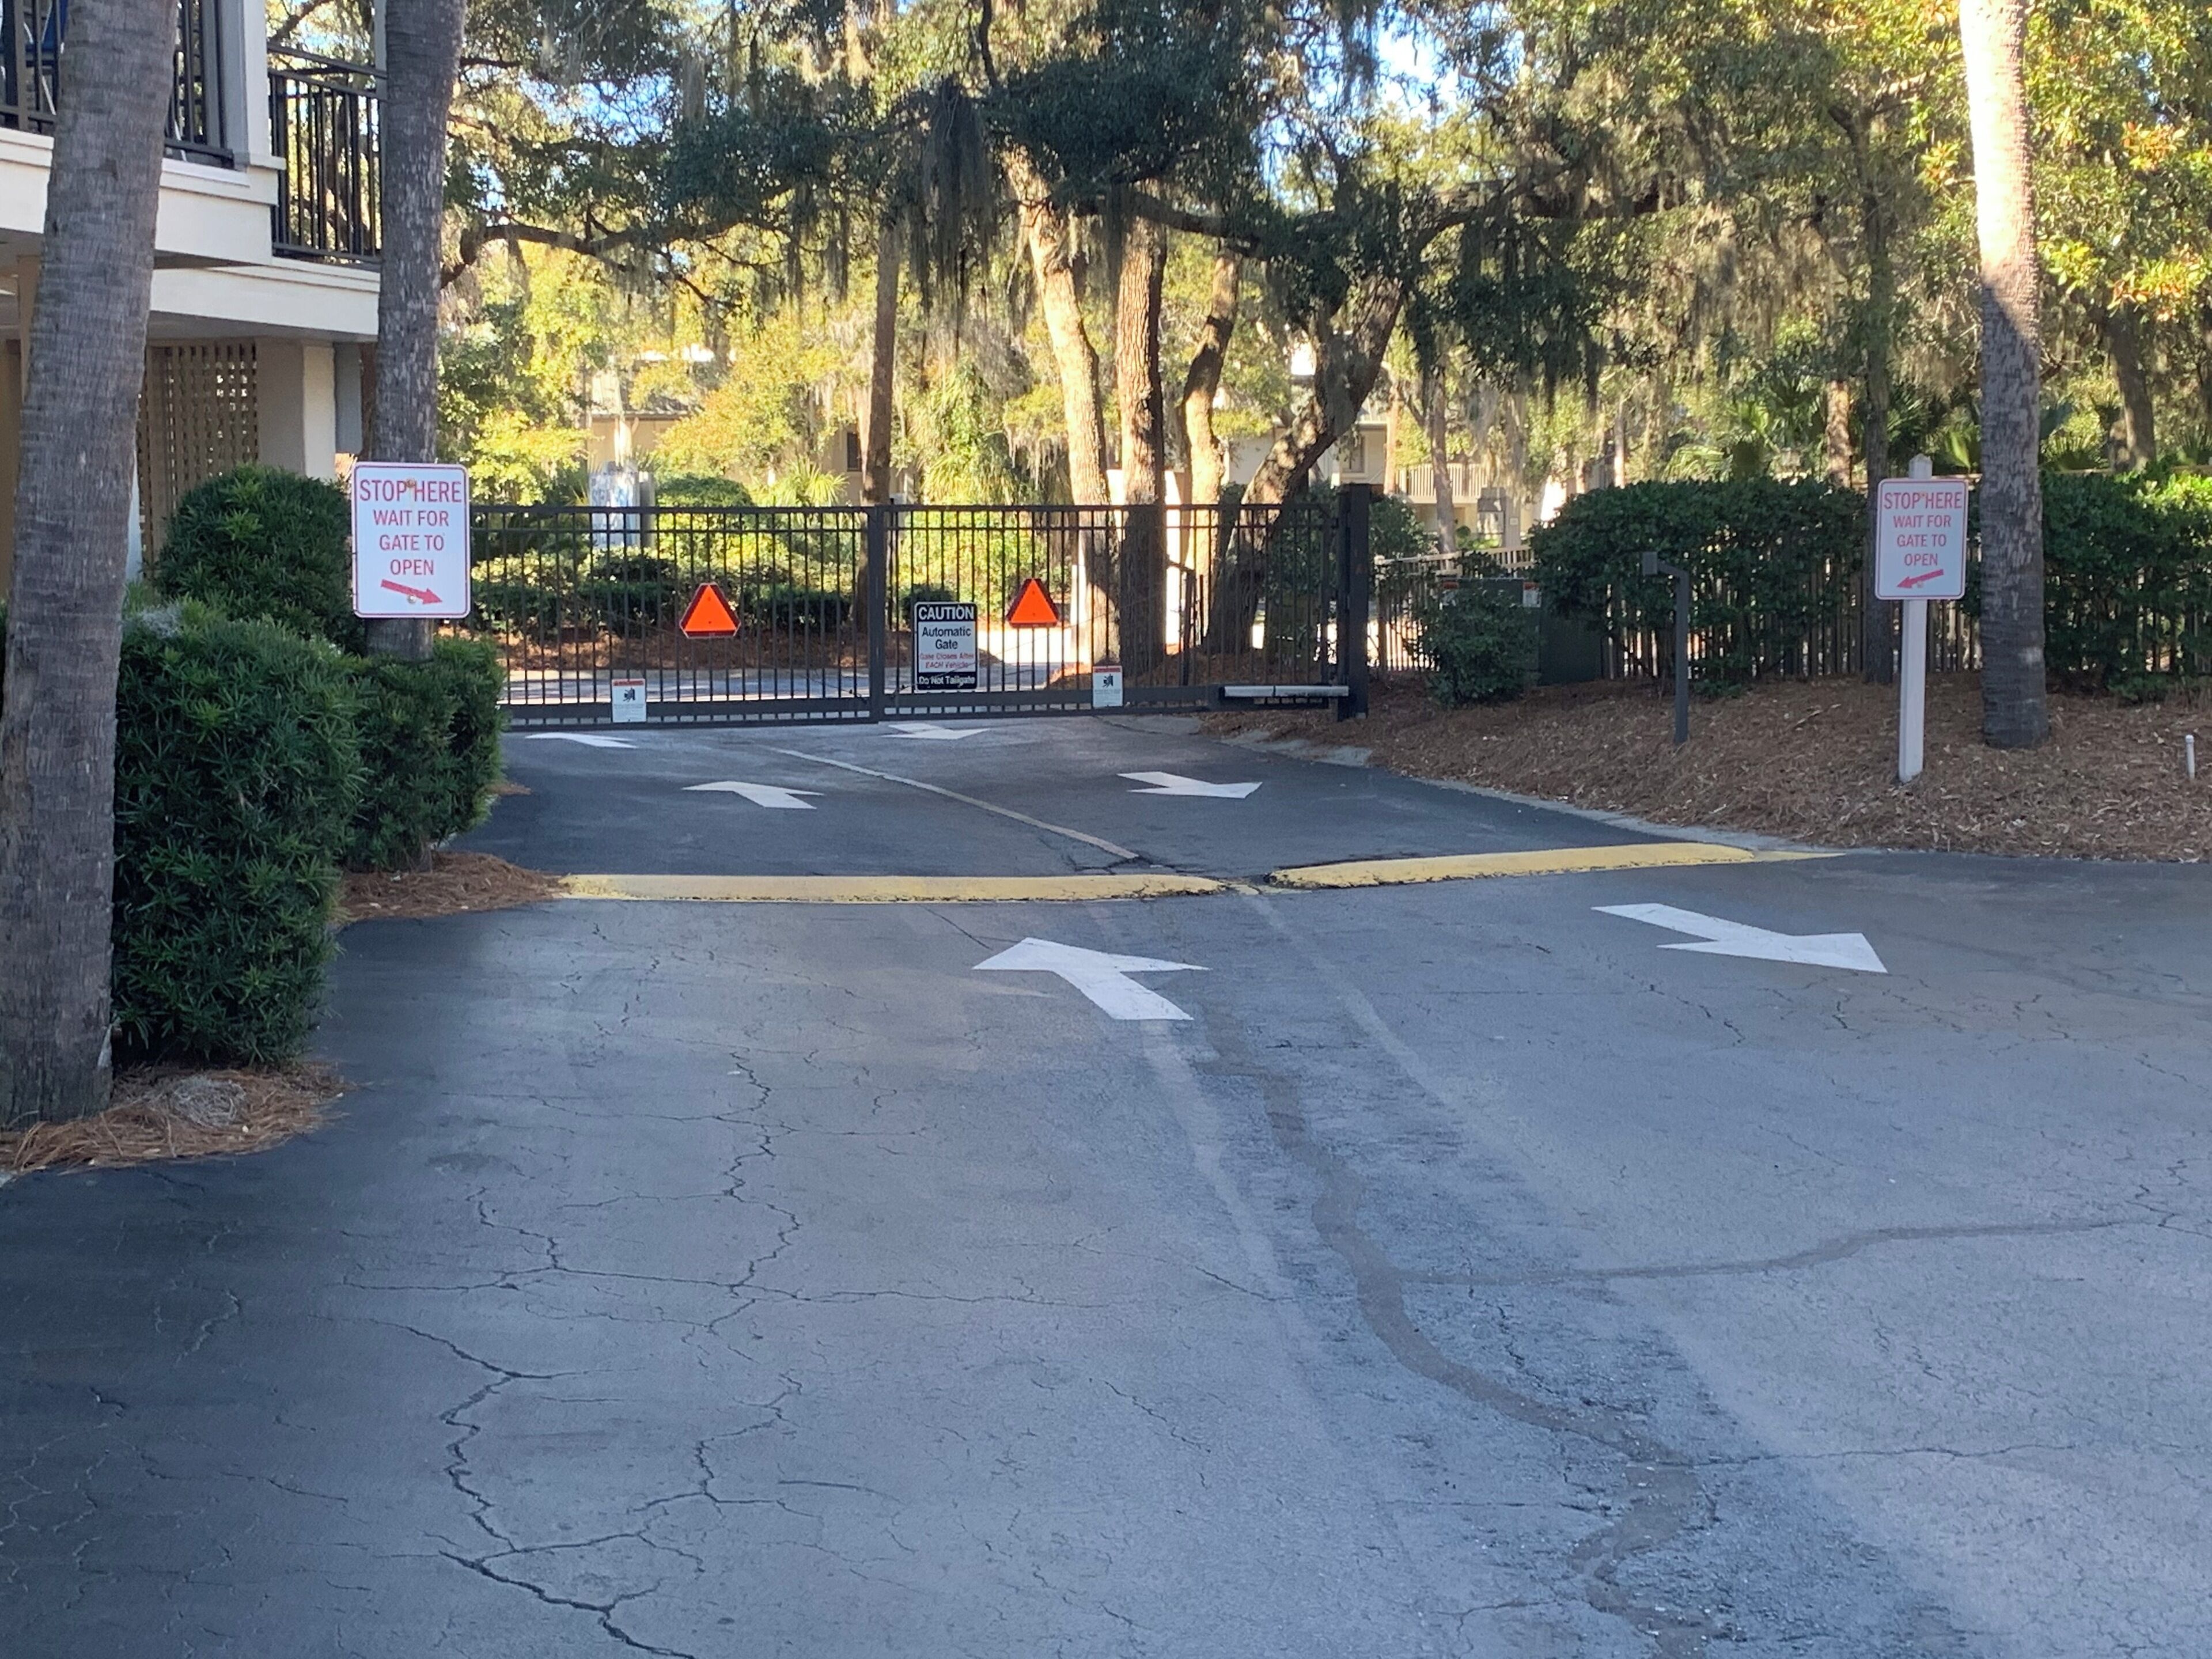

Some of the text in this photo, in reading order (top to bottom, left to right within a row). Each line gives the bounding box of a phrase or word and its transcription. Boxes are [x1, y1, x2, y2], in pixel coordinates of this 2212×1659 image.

[359, 479, 462, 503] STOP HERE
[1884, 492, 1963, 509] STOP HERE
[373, 509, 449, 527] WAIT FOR
[1893, 515, 1951, 528] WAIT FOR
[379, 535, 444, 551] GATE TO
[1896, 534, 1947, 547] GATE TO
[1904, 553, 1938, 566] OPEN
[390, 559, 434, 575] OPEN
[918, 606, 974, 620] CAUTION
[922, 626, 971, 637] Automatic
[935, 639, 959, 649] Gate
[919, 676, 975, 688] Do Not Tailgate
